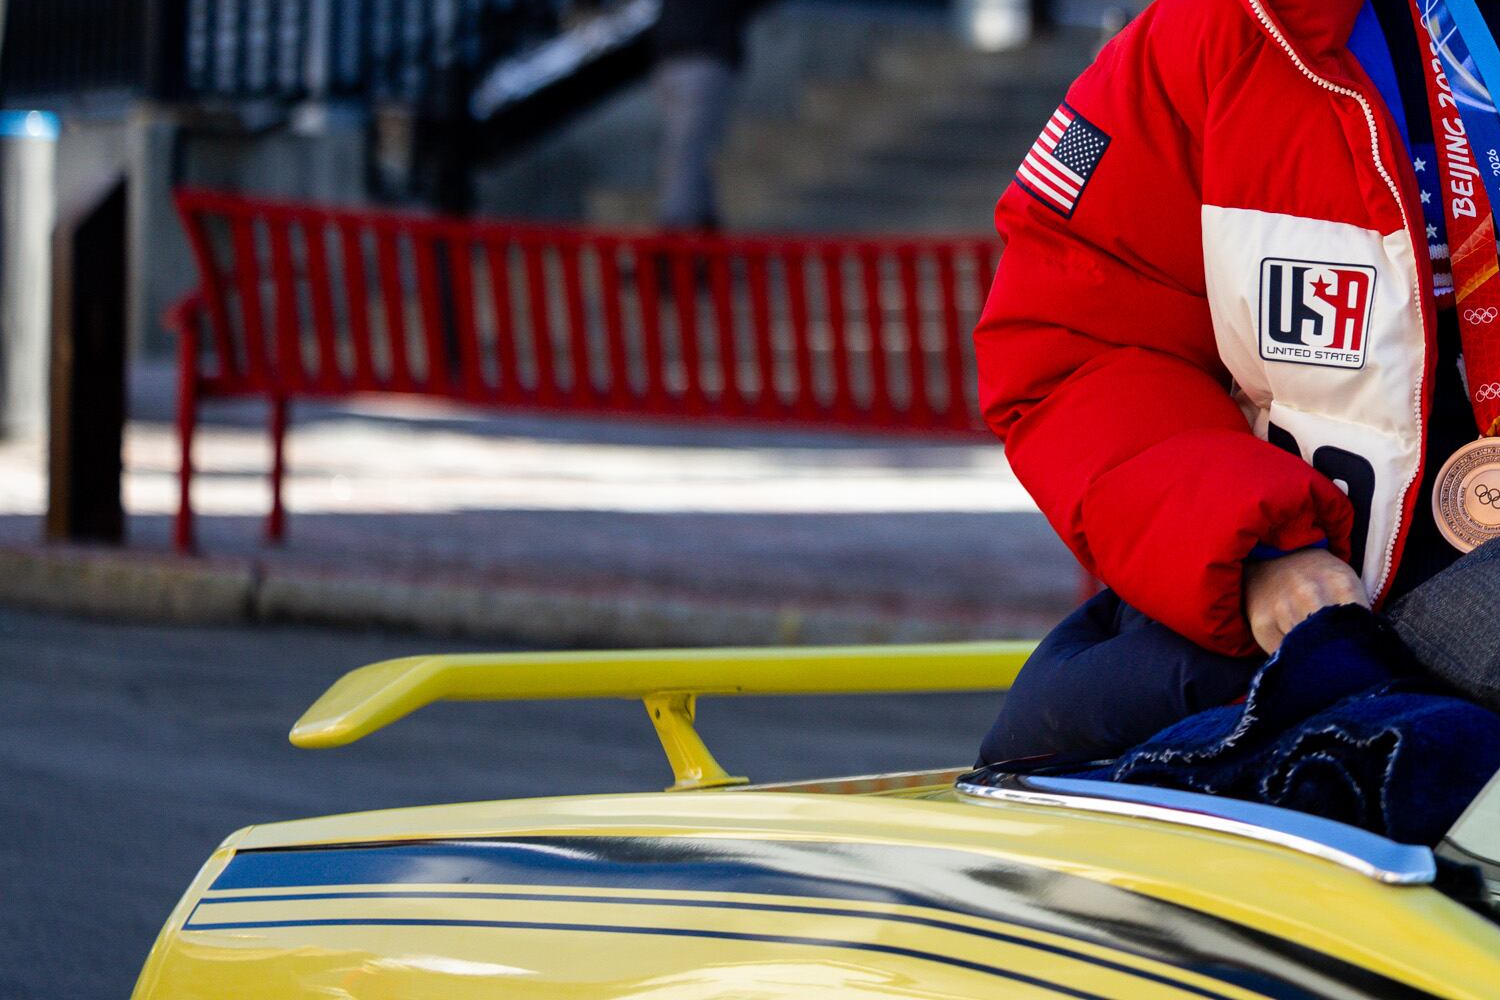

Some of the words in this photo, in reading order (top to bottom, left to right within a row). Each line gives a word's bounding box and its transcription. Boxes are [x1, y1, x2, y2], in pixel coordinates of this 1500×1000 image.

[1442, 116, 1479, 220] BEIJING
[1268, 264, 1369, 351] USA
[1266, 346, 1311, 358] UNITED
[1314, 351, 1360, 363] STATES
